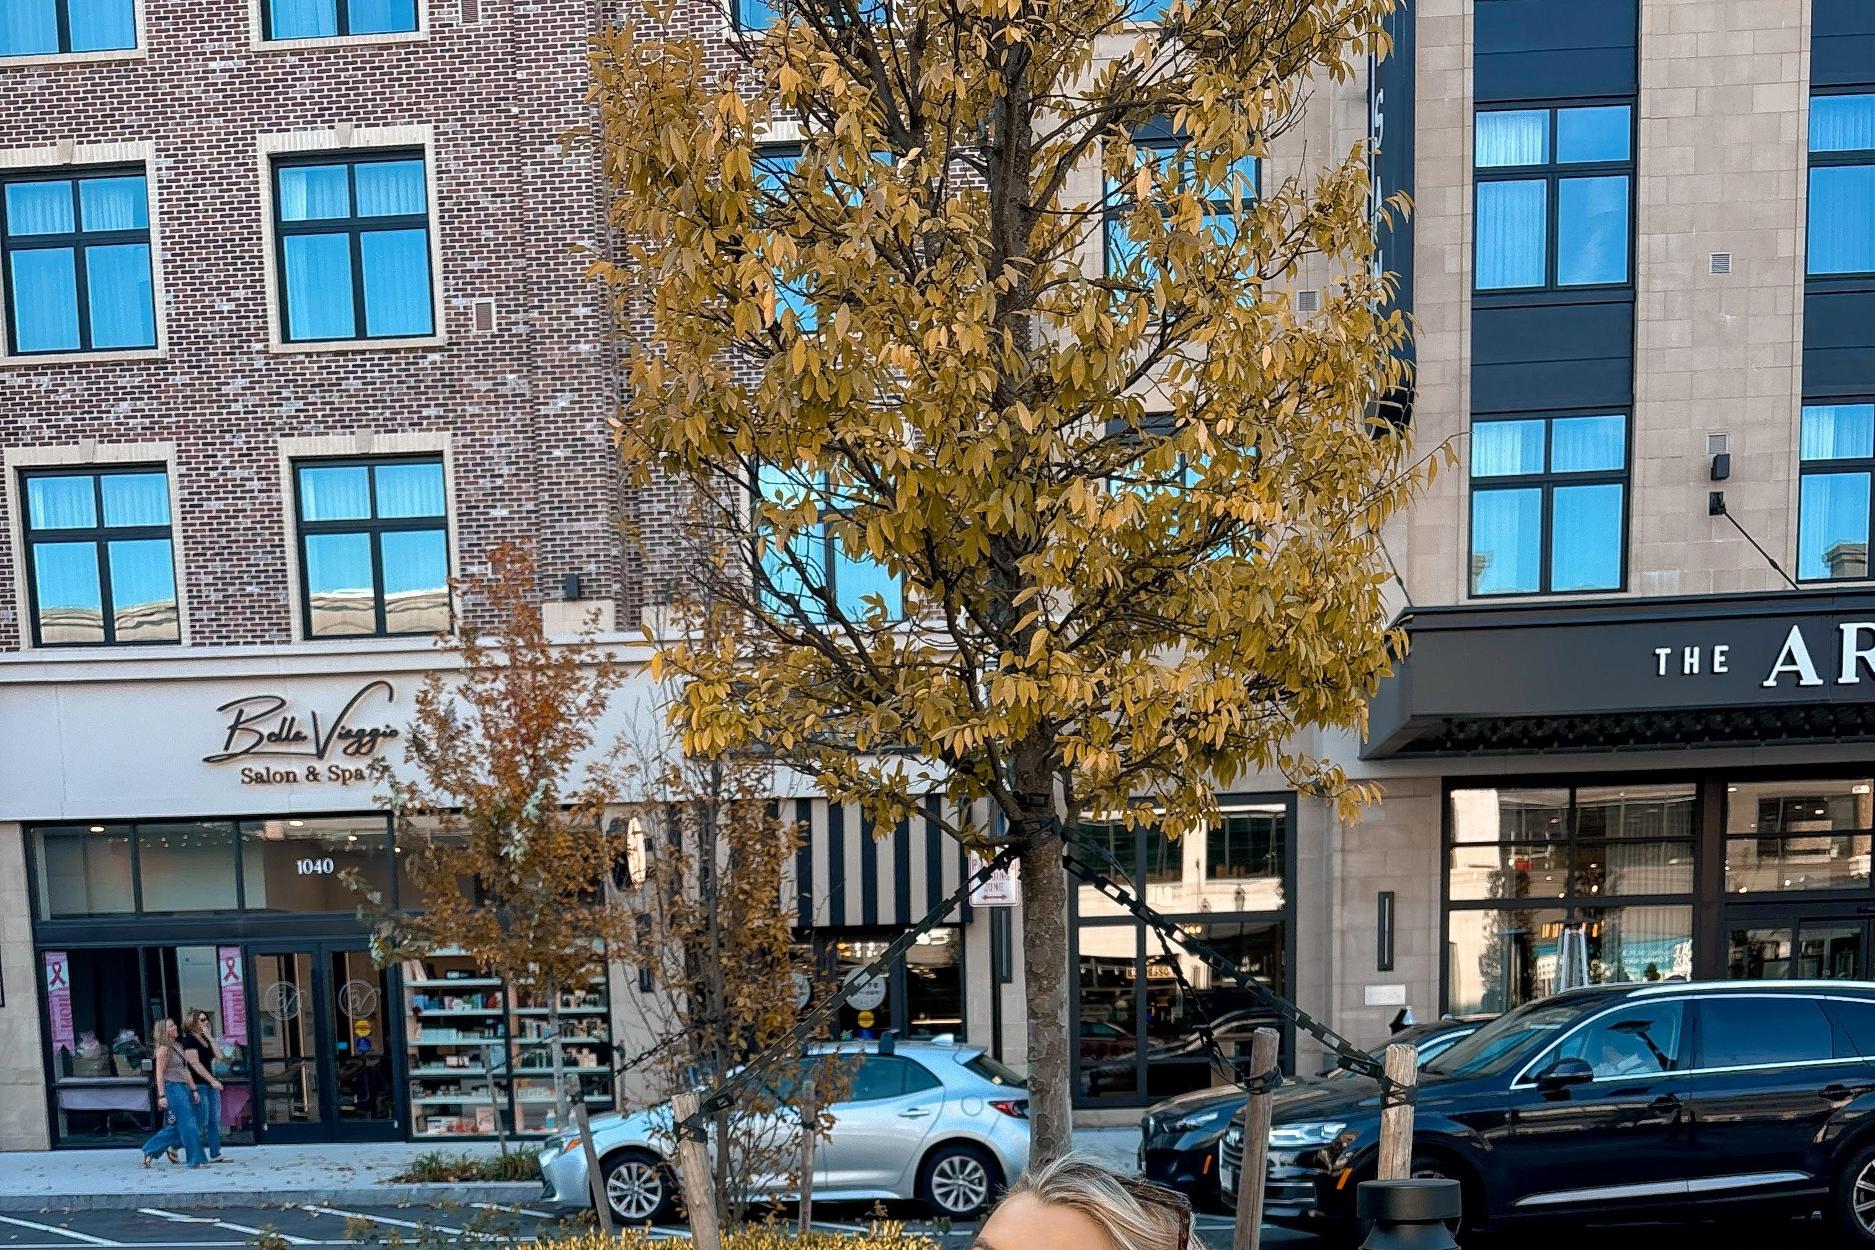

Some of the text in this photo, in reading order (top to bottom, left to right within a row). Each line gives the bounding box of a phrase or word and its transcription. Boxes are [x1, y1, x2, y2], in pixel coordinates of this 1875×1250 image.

[1654, 622, 1875, 687] THE AR
[240, 764, 367, 786] Salon & Spa
[295, 857, 335, 875] 1040
